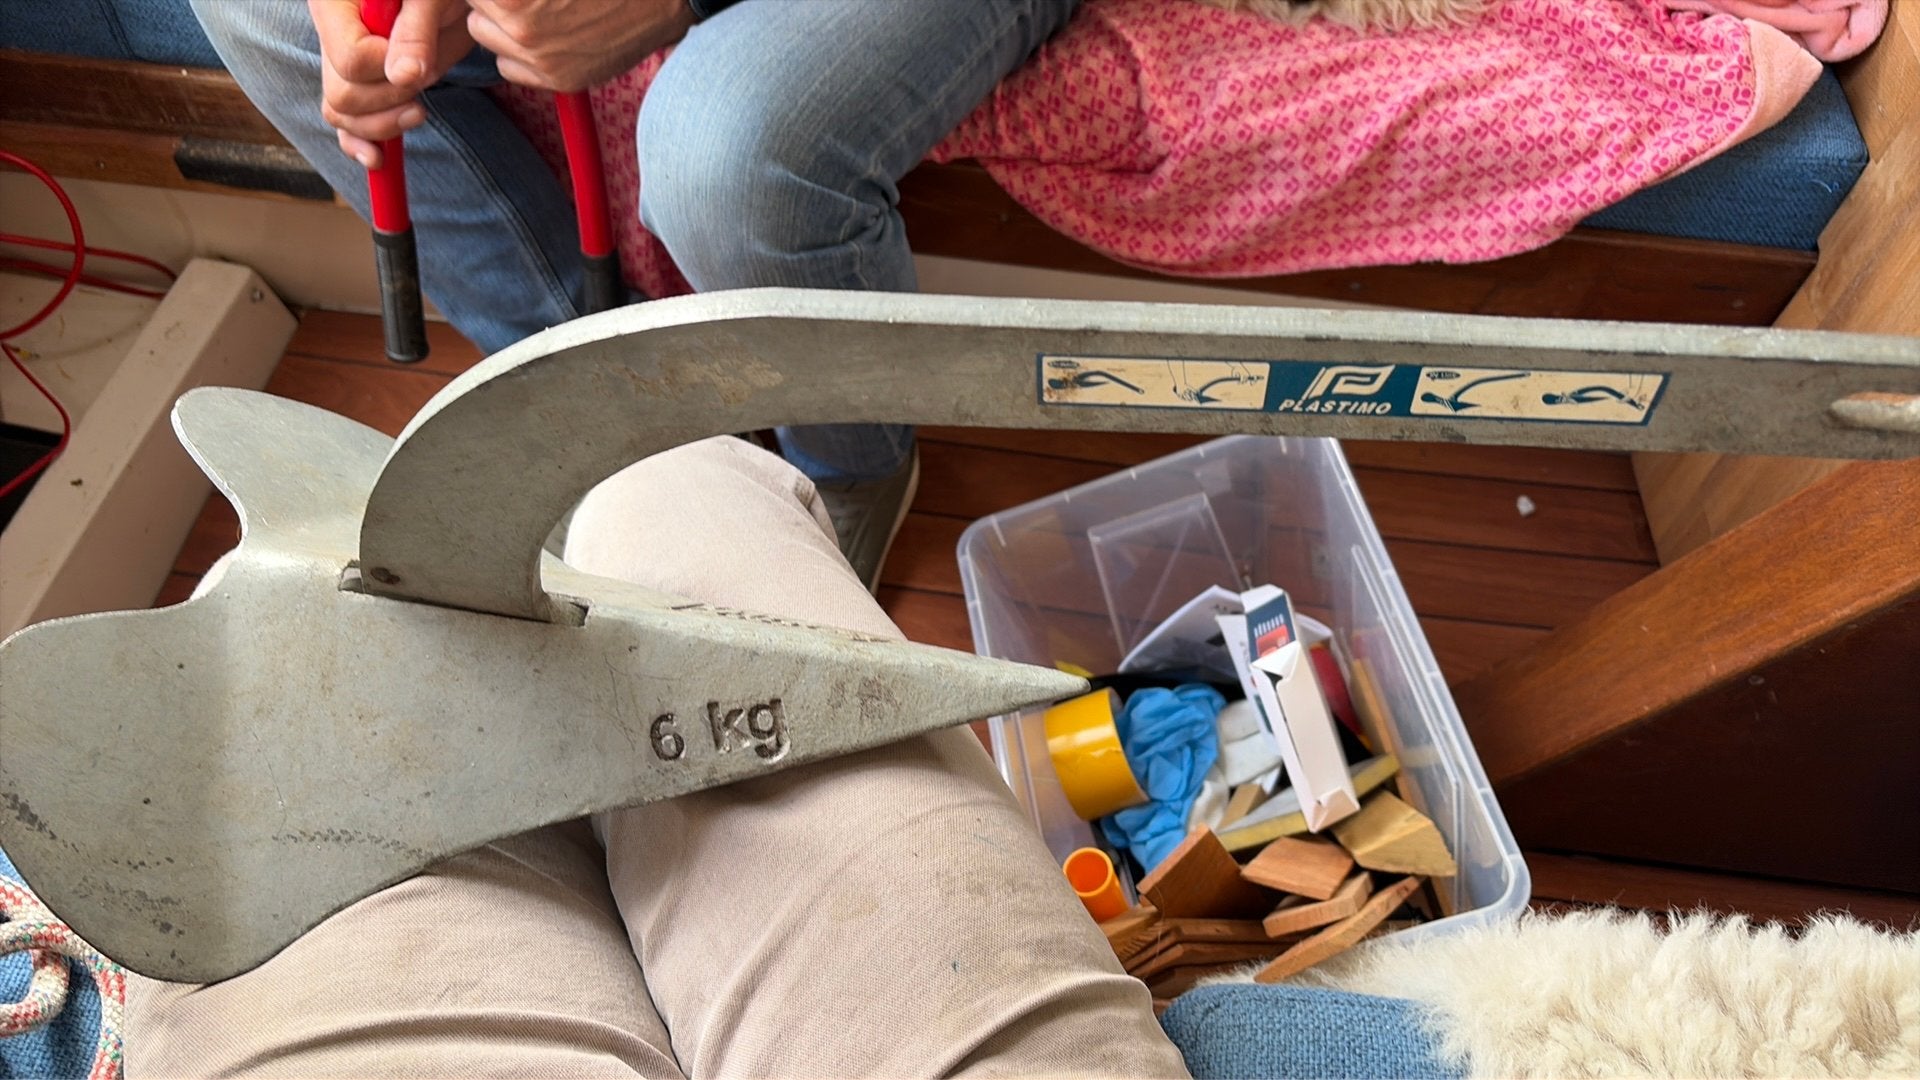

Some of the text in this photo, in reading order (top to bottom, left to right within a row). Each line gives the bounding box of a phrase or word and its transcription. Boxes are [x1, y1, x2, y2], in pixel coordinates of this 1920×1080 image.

[1279, 398, 1392, 415] PLASTIMO
[650, 698, 791, 764] 6 kg
